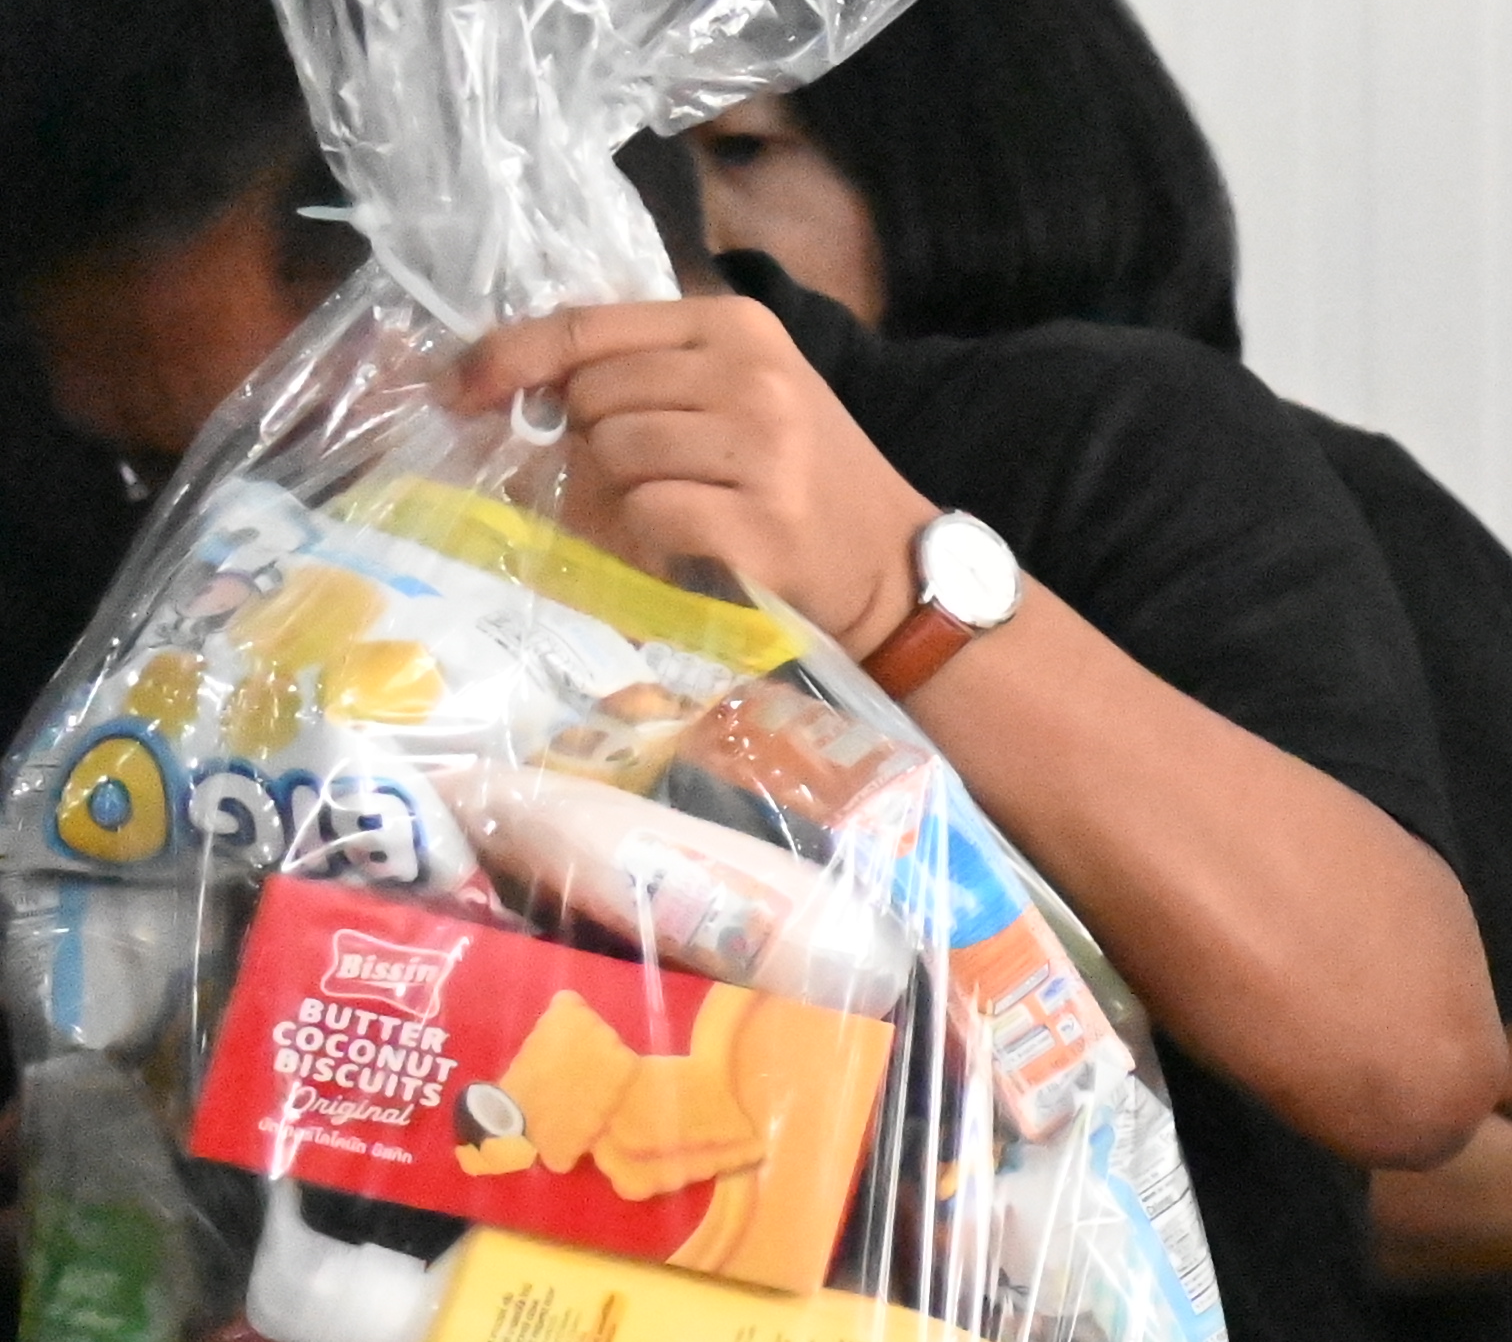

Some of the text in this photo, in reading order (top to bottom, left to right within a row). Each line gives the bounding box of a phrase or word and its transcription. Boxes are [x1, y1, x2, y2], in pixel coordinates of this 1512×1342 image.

[336, 953, 440, 983] Bissin
[272, 1020, 459, 1083] COCONUT
[298, 997, 450, 1054] BUTTER
[273, 1047, 444, 1107] BISCUITS
[285, 1085, 415, 1126] Original
